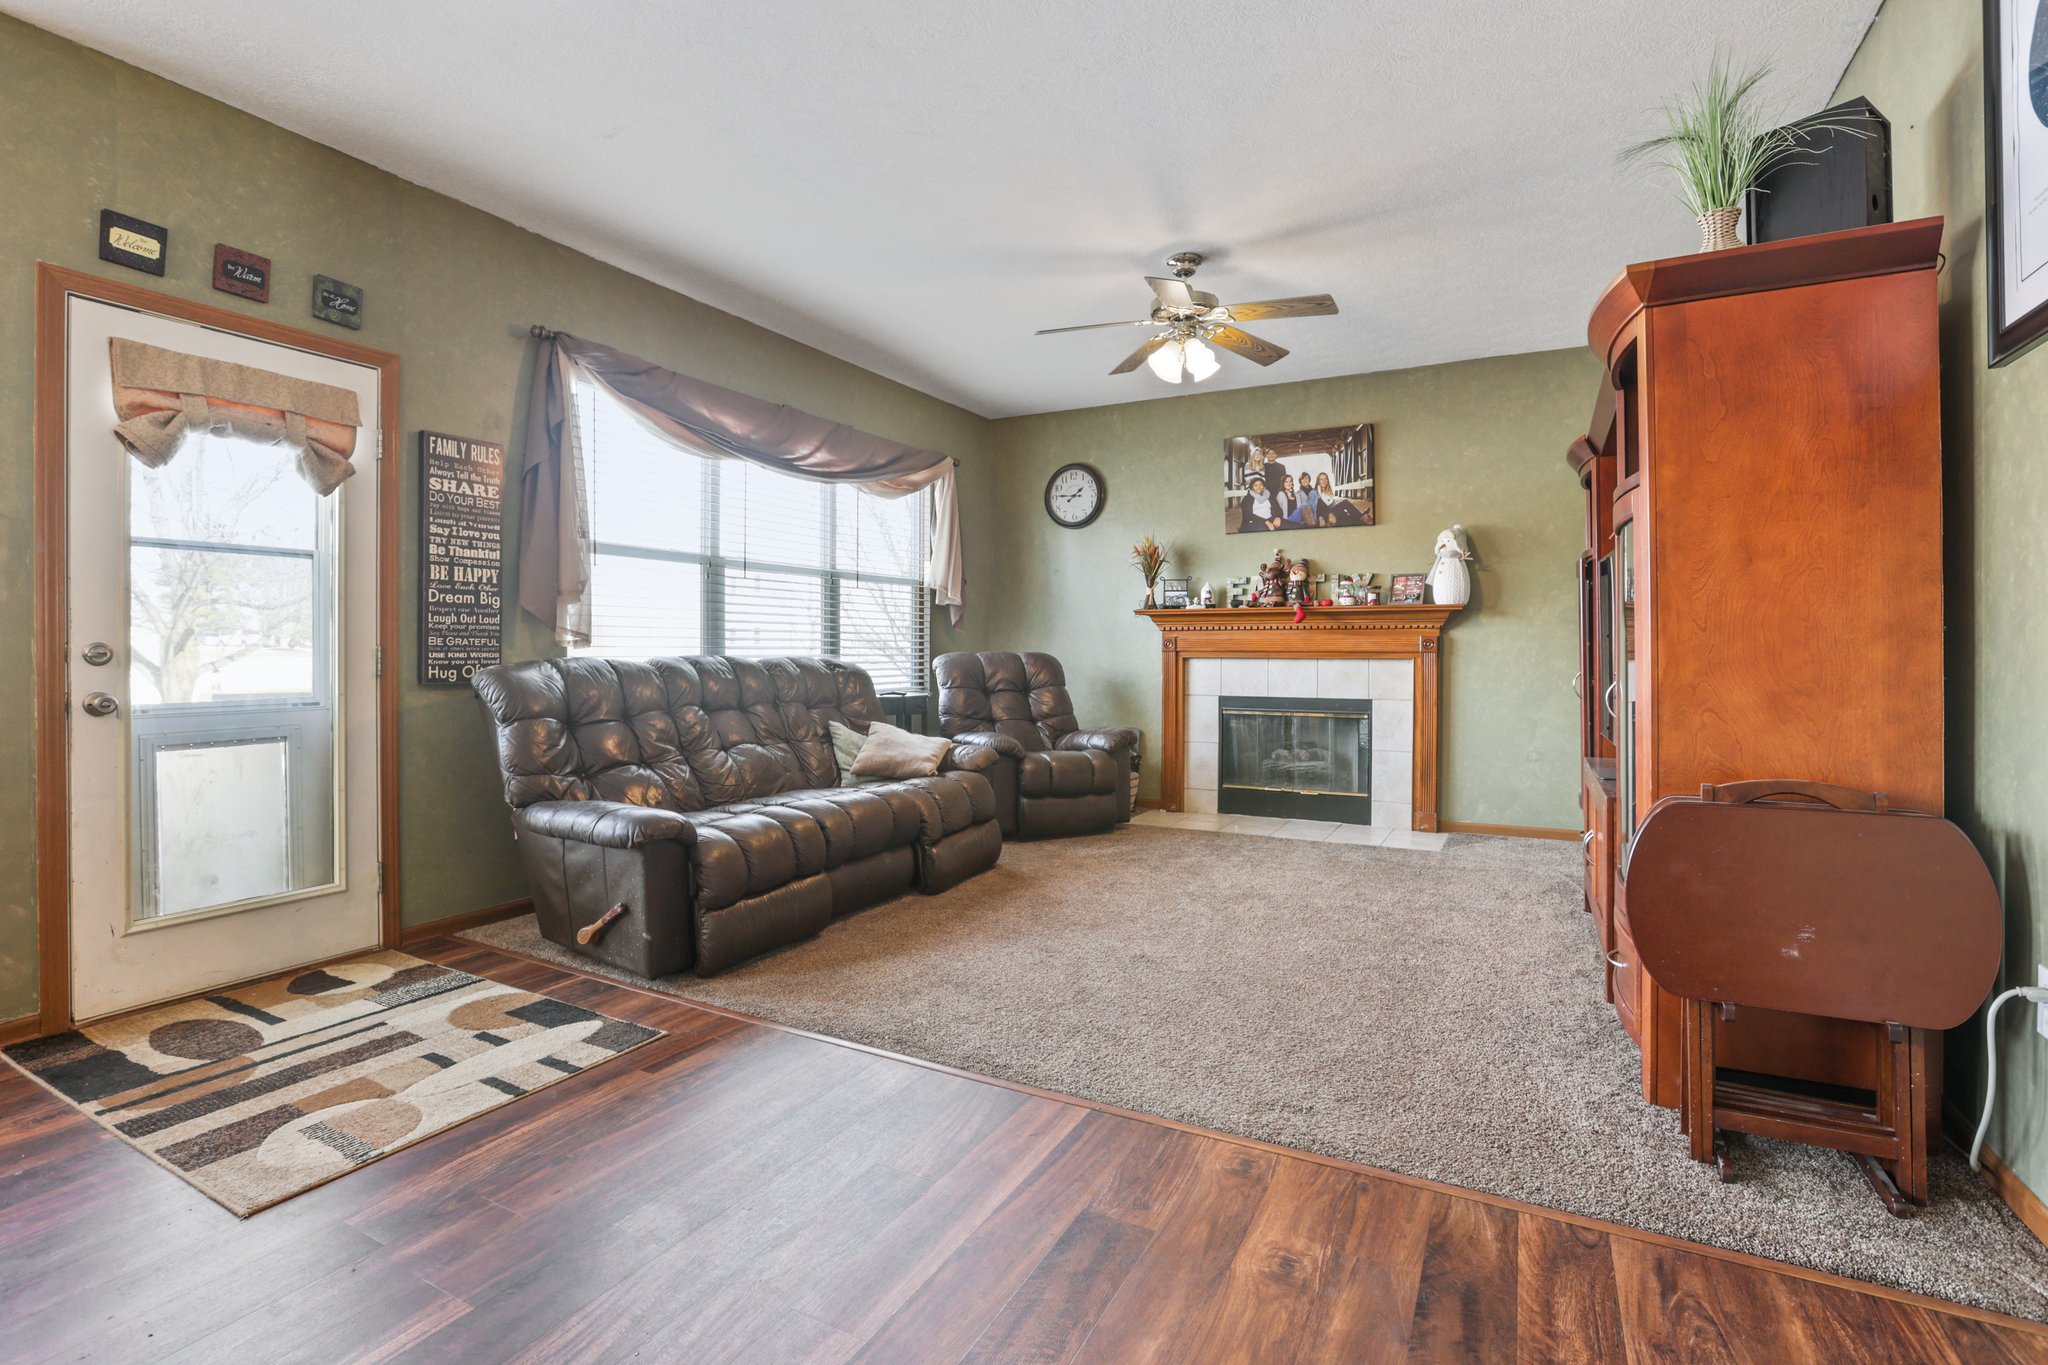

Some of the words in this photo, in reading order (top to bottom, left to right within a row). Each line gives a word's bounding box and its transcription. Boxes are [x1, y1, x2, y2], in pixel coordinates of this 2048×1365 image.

[113, 232, 158, 255] Welcome
[233, 265, 262, 283] Warm
[329, 296, 357, 312] Home
[430, 436, 467, 460] FAMILY
[471, 444, 500, 466] RULES
[430, 458, 450, 468] Help
[454, 462, 473, 471] Each
[477, 467, 500, 476] Other
[430, 466, 455, 478] Always
[456, 470, 469, 480] Tell
[470, 473, 481, 482] the
[483, 475, 500, 485] Truth
[428, 476, 500, 498] SHARE
[429, 524, 451, 536] Say
[452, 526, 458, 535] I
[458, 528, 480, 538] love
[481, 532, 500, 540] you
[429, 536, 448, 544] TRY
[450, 538, 469, 546] NEW
[472, 540, 500, 549] THINGS
[429, 543, 445, 555] Be
[448, 546, 500, 560] Thankful
[454, 557, 500, 567] Compassion
[430, 564, 449, 580] BE
[453, 566, 499, 584] HAPPY
[430, 581, 451, 589] Love
[454, 583, 475, 591] Each
[478, 584, 499, 592] Other
[428, 589, 474, 604] Dream
[480, 592, 500, 608] Big
[428, 613, 457, 624] Laugh
[460, 614, 476, 624] Out
[479, 614, 500, 624] Loud
[468, 624, 500, 632] promises
[428, 666, 457, 682] Hug
